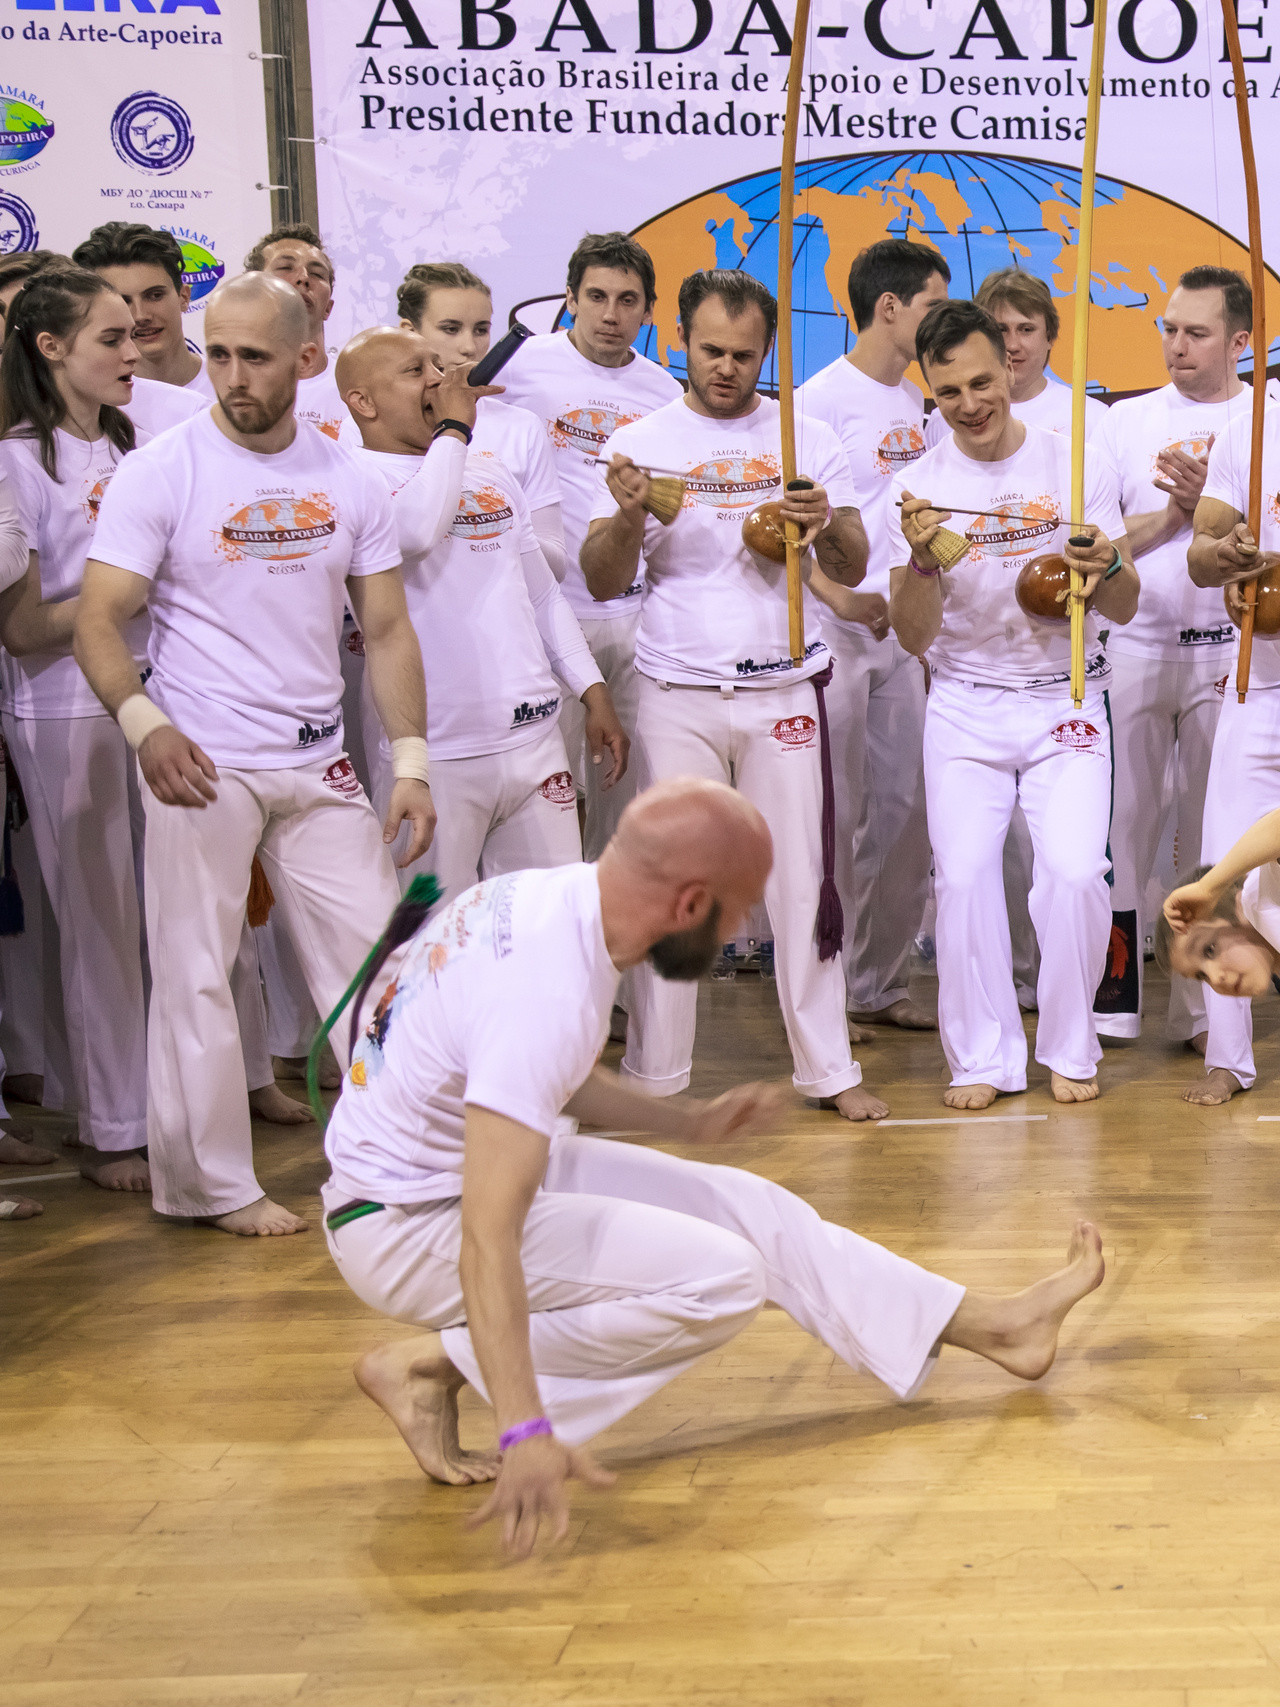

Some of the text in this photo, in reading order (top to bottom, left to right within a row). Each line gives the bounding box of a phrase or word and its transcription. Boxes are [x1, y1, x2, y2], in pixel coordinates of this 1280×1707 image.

[22, 20, 51, 41] da
[58, 21, 223, 50] Arte-Capoeira
[359, 56, 546, 96] Associação
[557, 59, 720, 93] Brasileira
[731, 63, 769, 92] de
[781, 65, 881, 103] poio
[892, 74, 909, 95] e
[359, 94, 1088, 141] Presidente Fundador: Mestre Camisa
[160, 224, 216, 251] SAMARA
[685, 479, 777, 492] ABADÁ-CAPOEIRA
[229, 525, 332, 541] ABADÁ-CAPOEIRA
